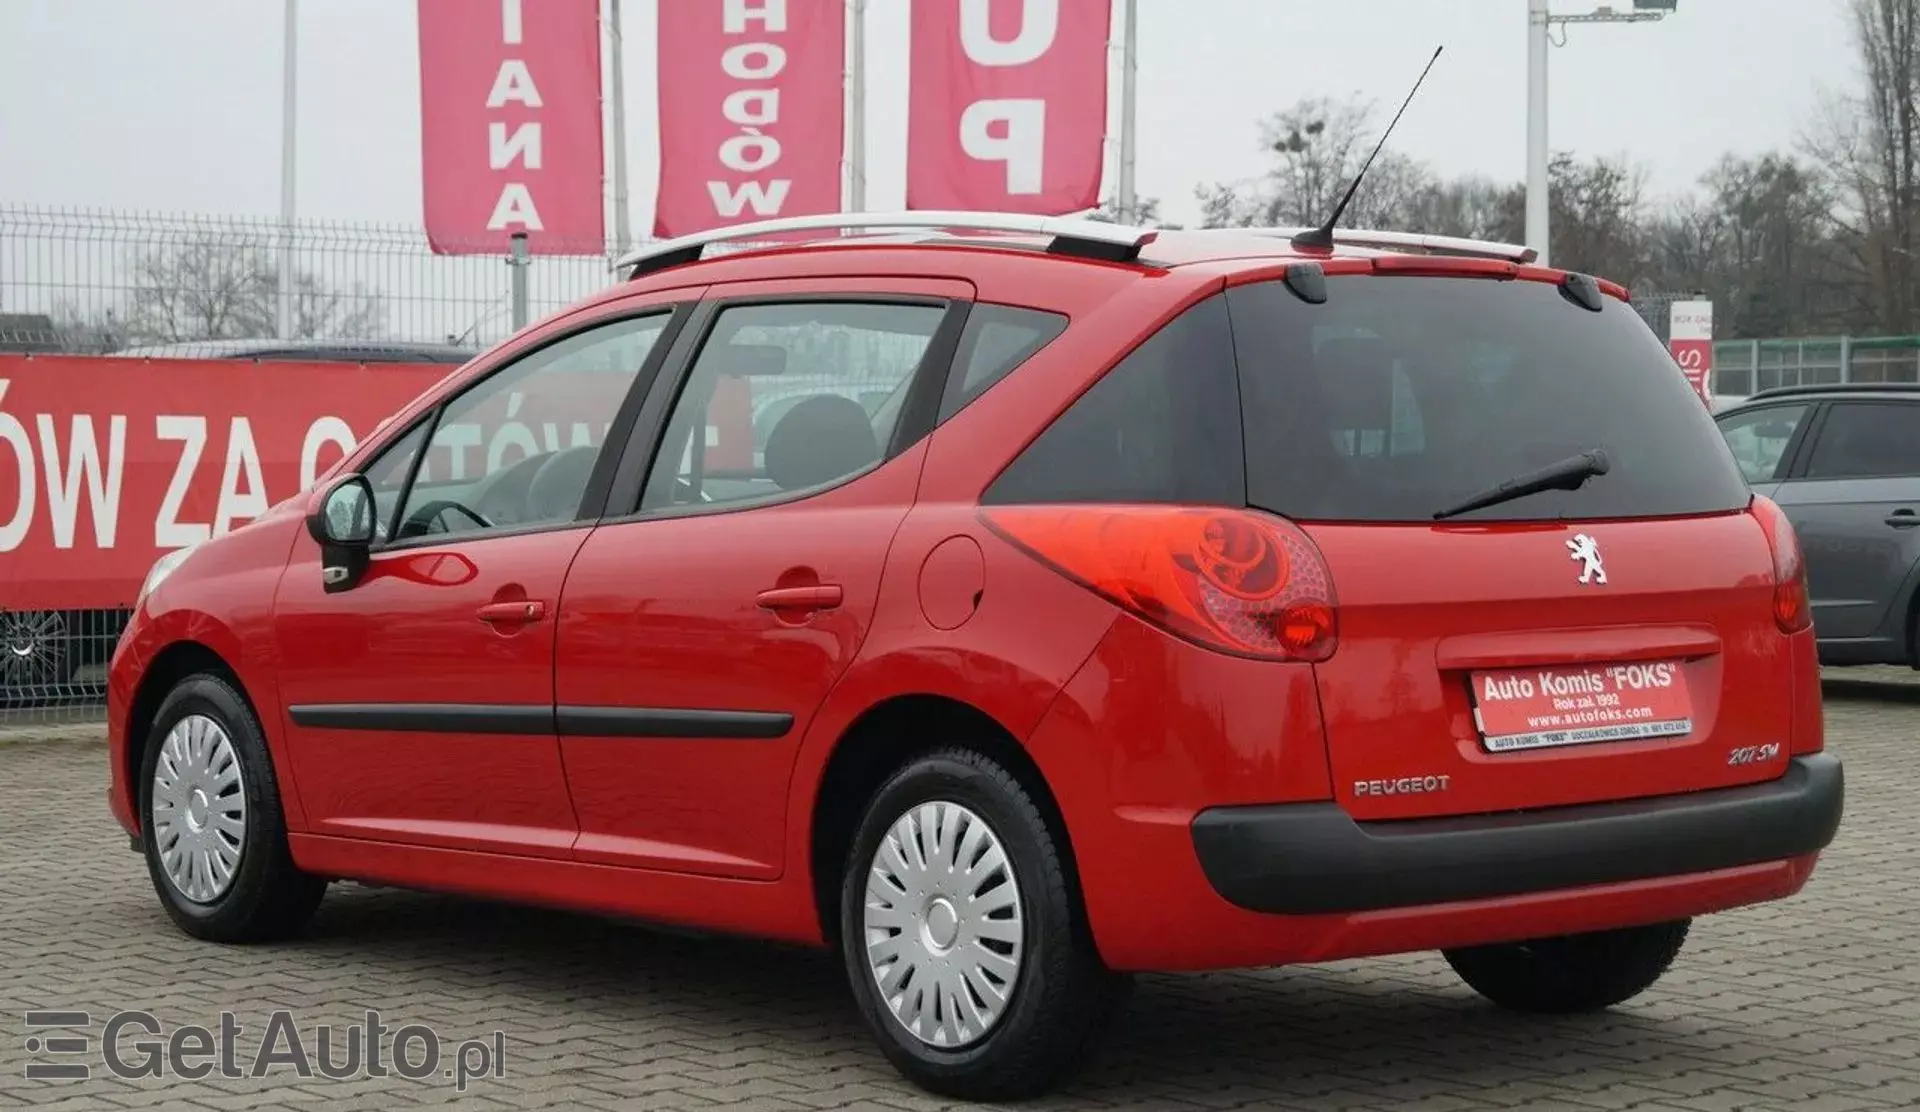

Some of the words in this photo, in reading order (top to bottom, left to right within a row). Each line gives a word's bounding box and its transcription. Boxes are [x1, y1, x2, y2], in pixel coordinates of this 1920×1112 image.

[155, 415, 269, 548] ZA
[1484, 676, 1534, 701] Auto
[1538, 669, 1604, 696] Komis
[1605, 662, 1676, 690] "FOKS"
[1553, 697, 1576, 711] Rok
[1595, 692, 1620, 706] 1992
[1527, 706, 1653, 727] www.autofoks.com
[1727, 746, 1758, 766] 207
[1353, 775, 1450, 797] PEUGEOT
